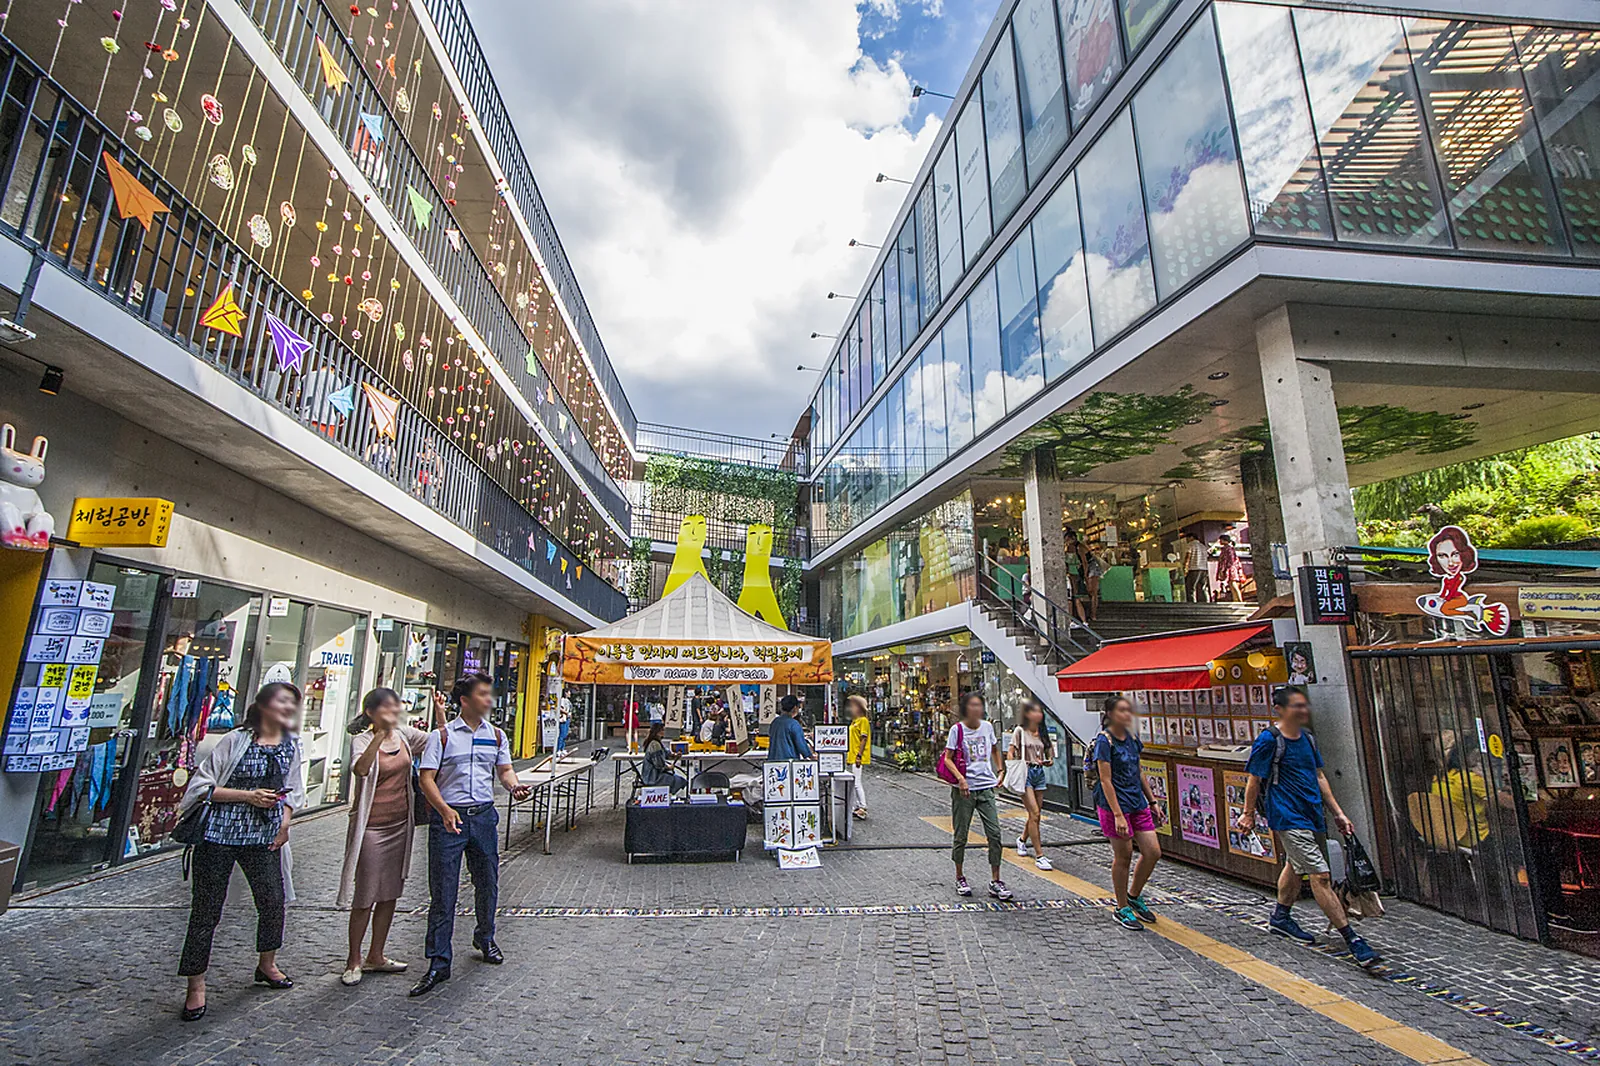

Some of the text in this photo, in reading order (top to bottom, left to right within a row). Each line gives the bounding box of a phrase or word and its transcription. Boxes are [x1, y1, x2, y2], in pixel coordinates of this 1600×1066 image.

[76, 506, 150, 527] 체험공방
[1316, 583, 1344, 597] 캐리
[321, 651, 355, 667] TRAVEL
[598, 643, 635, 661] 이름을
[681, 646, 749, 662] 써드립니다,
[630, 665, 768, 680] Your name in Korean.
[821, 737, 846, 747] KOREAN
[645, 794, 668, 804] NAME
